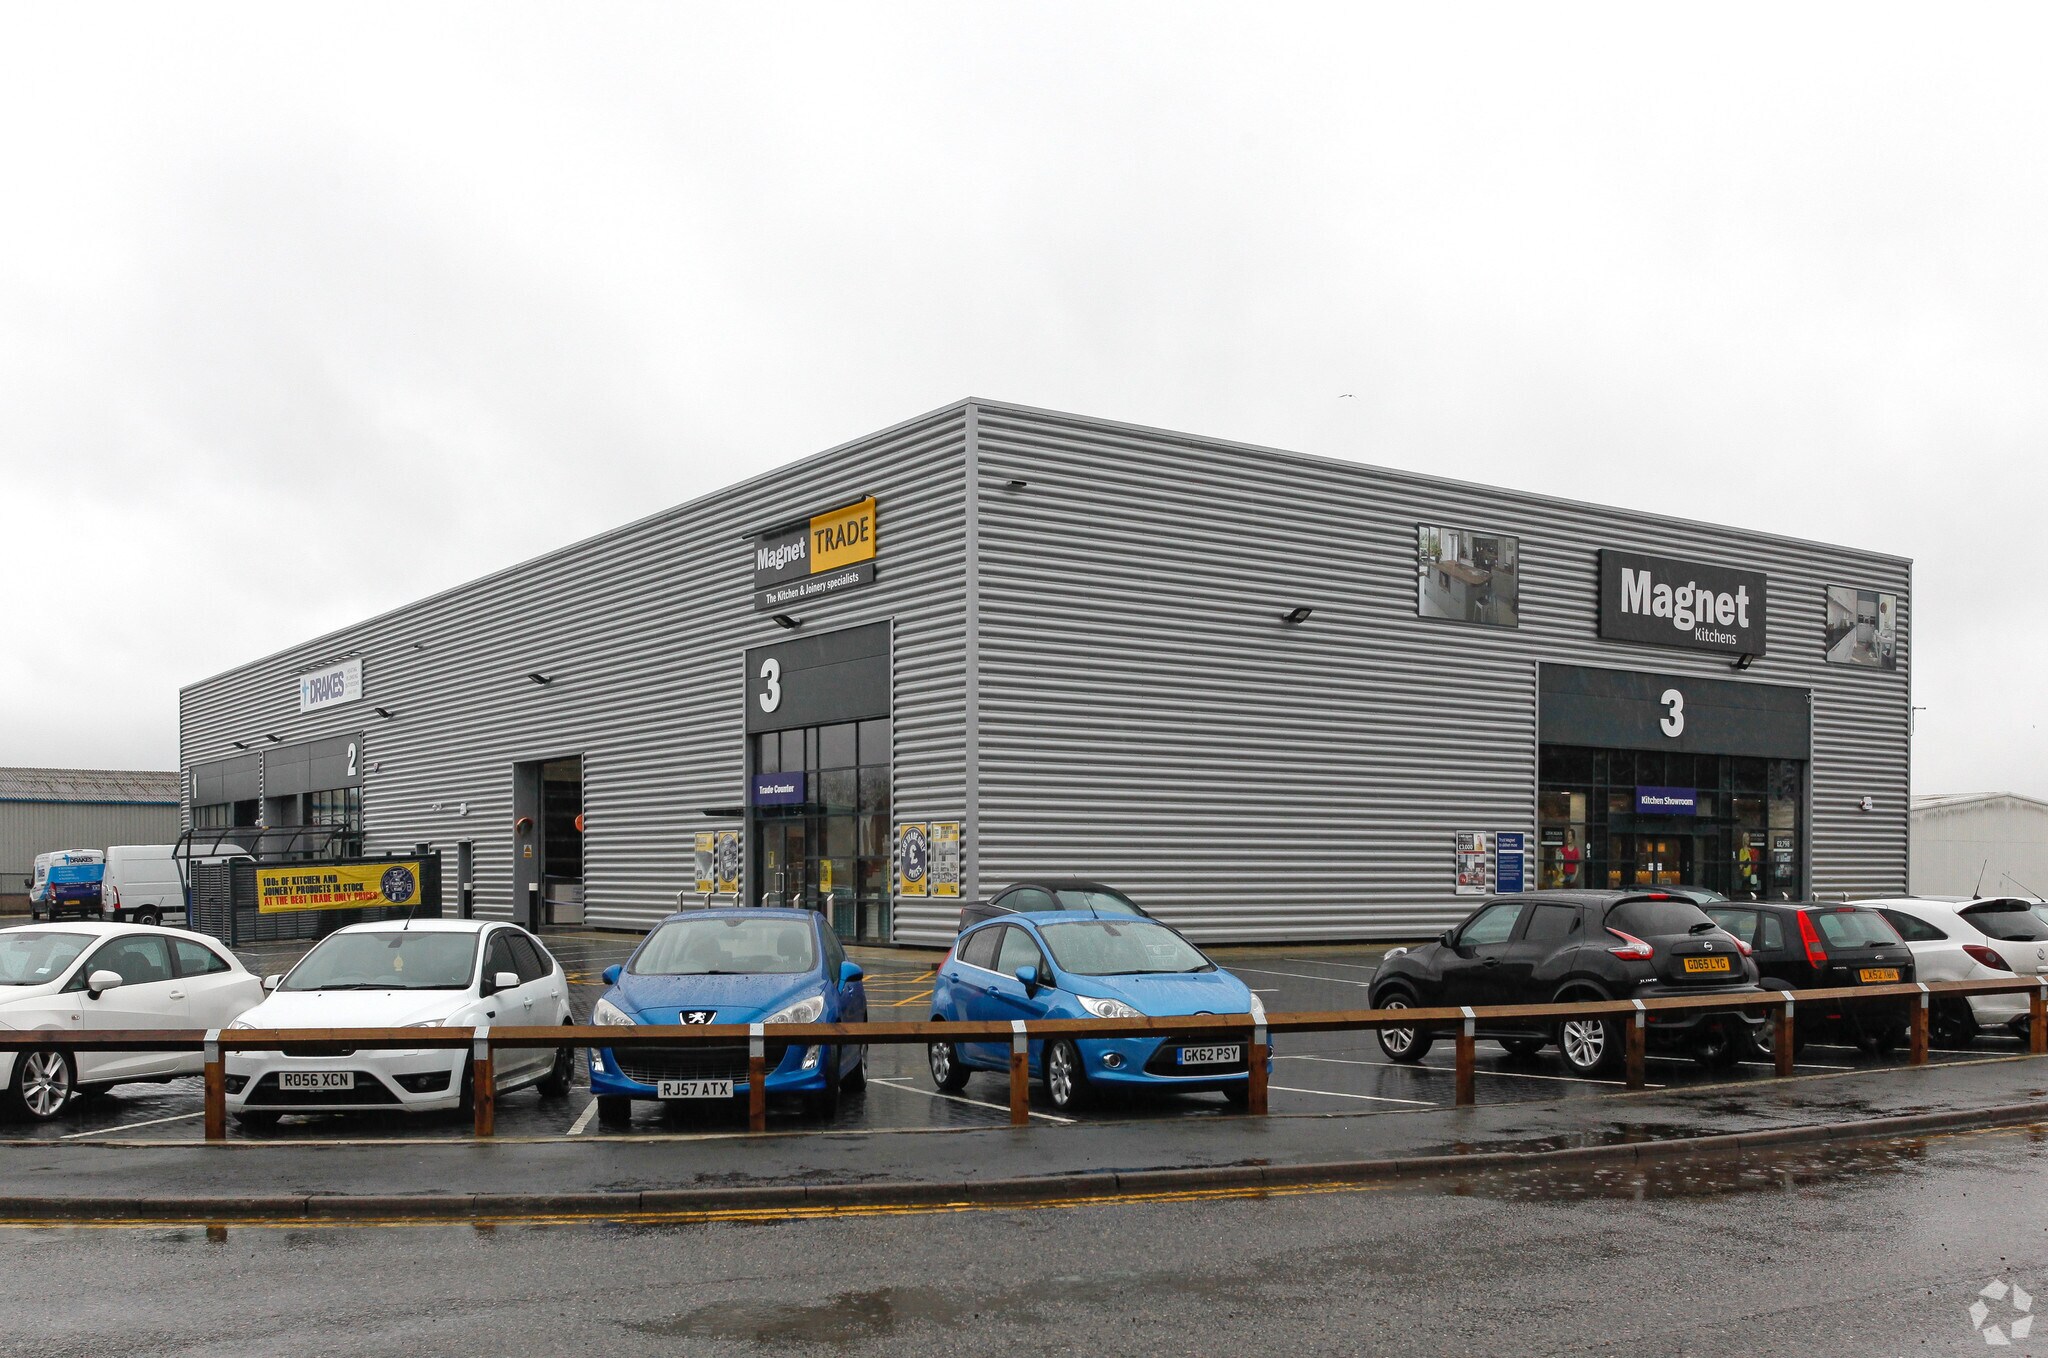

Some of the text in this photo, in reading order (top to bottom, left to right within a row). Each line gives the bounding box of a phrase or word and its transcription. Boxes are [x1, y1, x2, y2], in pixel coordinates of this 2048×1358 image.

[757, 516, 869, 570] Magnet TRADE
[766, 572, 859, 604] The Kitchen & Joinery specialists
[1621, 567, 1750, 631] Magnet
[1695, 627, 1737, 645] Kitchens
[310, 671, 344, 704] DRAKES
[759, 658, 781, 713] 3
[1659, 688, 1685, 737] 3
[347, 742, 357, 777] 2
[192, 773, 197, 799] 1
[759, 784, 795, 795] Trade Counter
[1641, 795, 1694, 806] Kitchen Showroom
[263, 874, 338, 887] 100s OF KITCHEN AND
[263, 882, 364, 896] JOINERY PRODUCTS IN STOCK
[264, 896, 273, 906] AT
[276, 896, 288, 905] THE
[290, 894, 307, 904] BEST
[310, 893, 332, 904] TRADE
[334, 892, 352, 902] ONLY
[1688, 958, 1726, 970] GD65 LYG
[1184, 1047, 1238, 1062] GK62 PSY
[322, 1073, 348, 1086] XCN
[663, 1082, 728, 1096] RJ57 ATX
